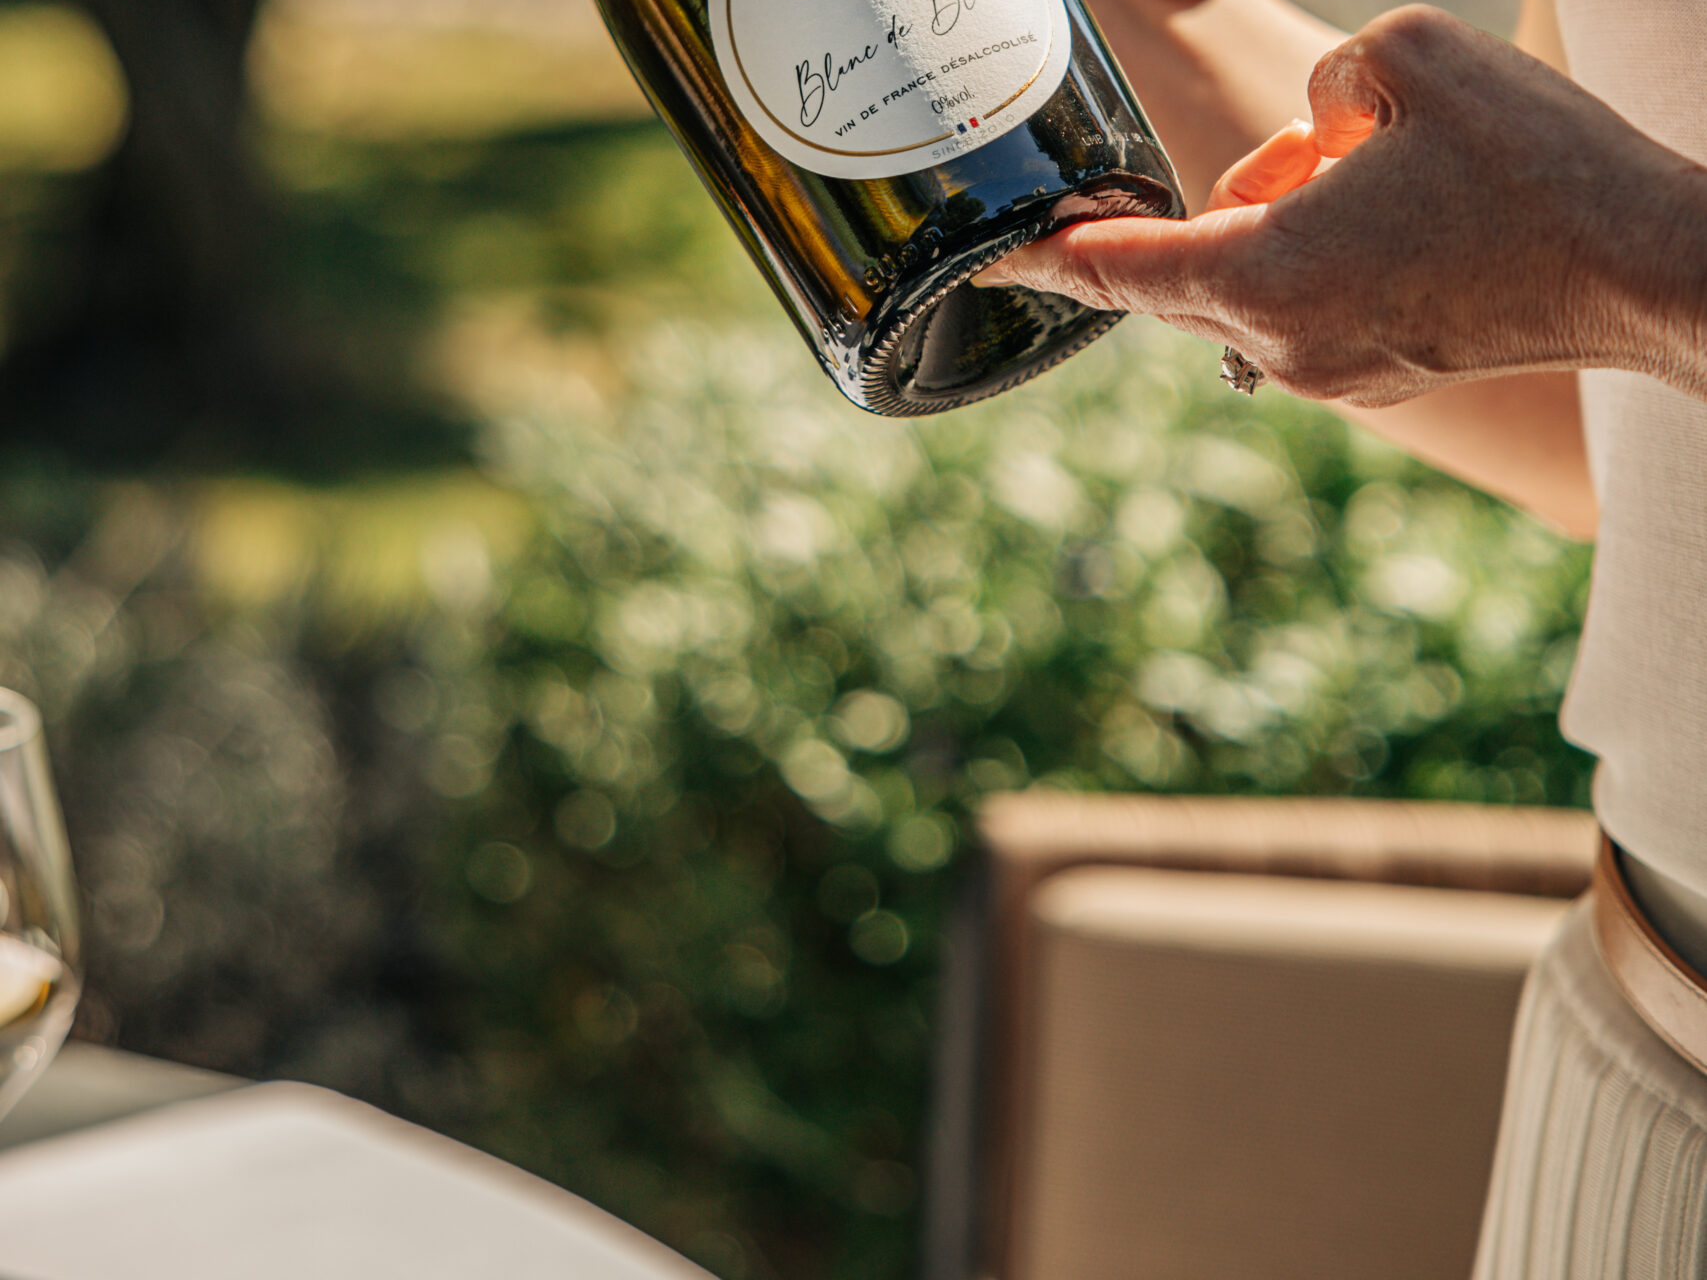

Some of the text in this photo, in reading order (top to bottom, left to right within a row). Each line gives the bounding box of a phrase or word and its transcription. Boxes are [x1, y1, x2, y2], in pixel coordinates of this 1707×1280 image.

[795, 44, 878, 127] Blanc
[887, 15, 914, 49] de
[835, 31, 1038, 137] VIN DE FRANCE DÉSALCOOLISÉ
[932, 136, 973, 159] SINCE
